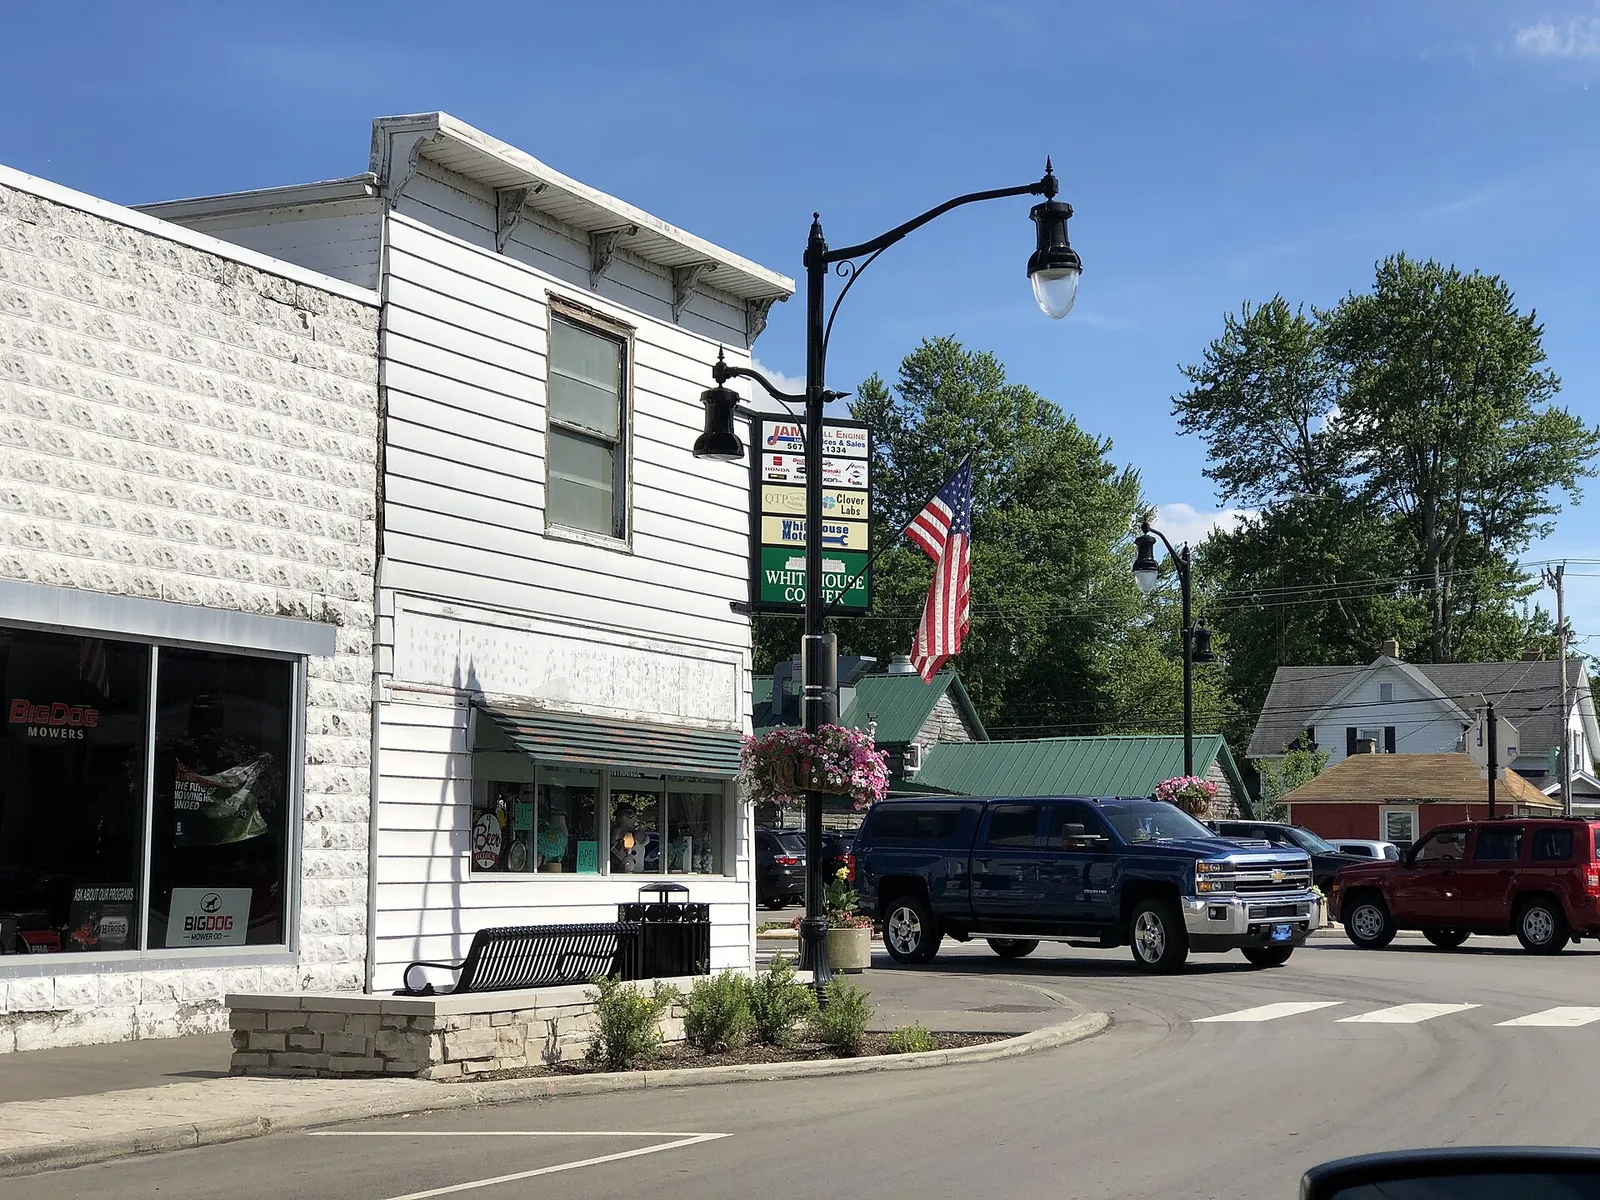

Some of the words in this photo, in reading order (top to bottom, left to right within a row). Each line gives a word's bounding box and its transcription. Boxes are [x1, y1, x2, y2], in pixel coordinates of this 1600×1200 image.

[846, 440, 865, 448] Sales
[765, 492, 788, 505] QTP
[836, 493, 865, 505] Clover
[841, 504, 861, 516] Labs
[28, 726, 84, 740] MOWERS
[579, 849, 597, 867] OPEN
[73, 888, 83, 901] ASK
[83, 888, 99, 901] ABOUT
[99, 888, 109, 901] OUR
[184, 915, 234, 931] BIGDOG
[191, 933, 213, 941] MOWER
